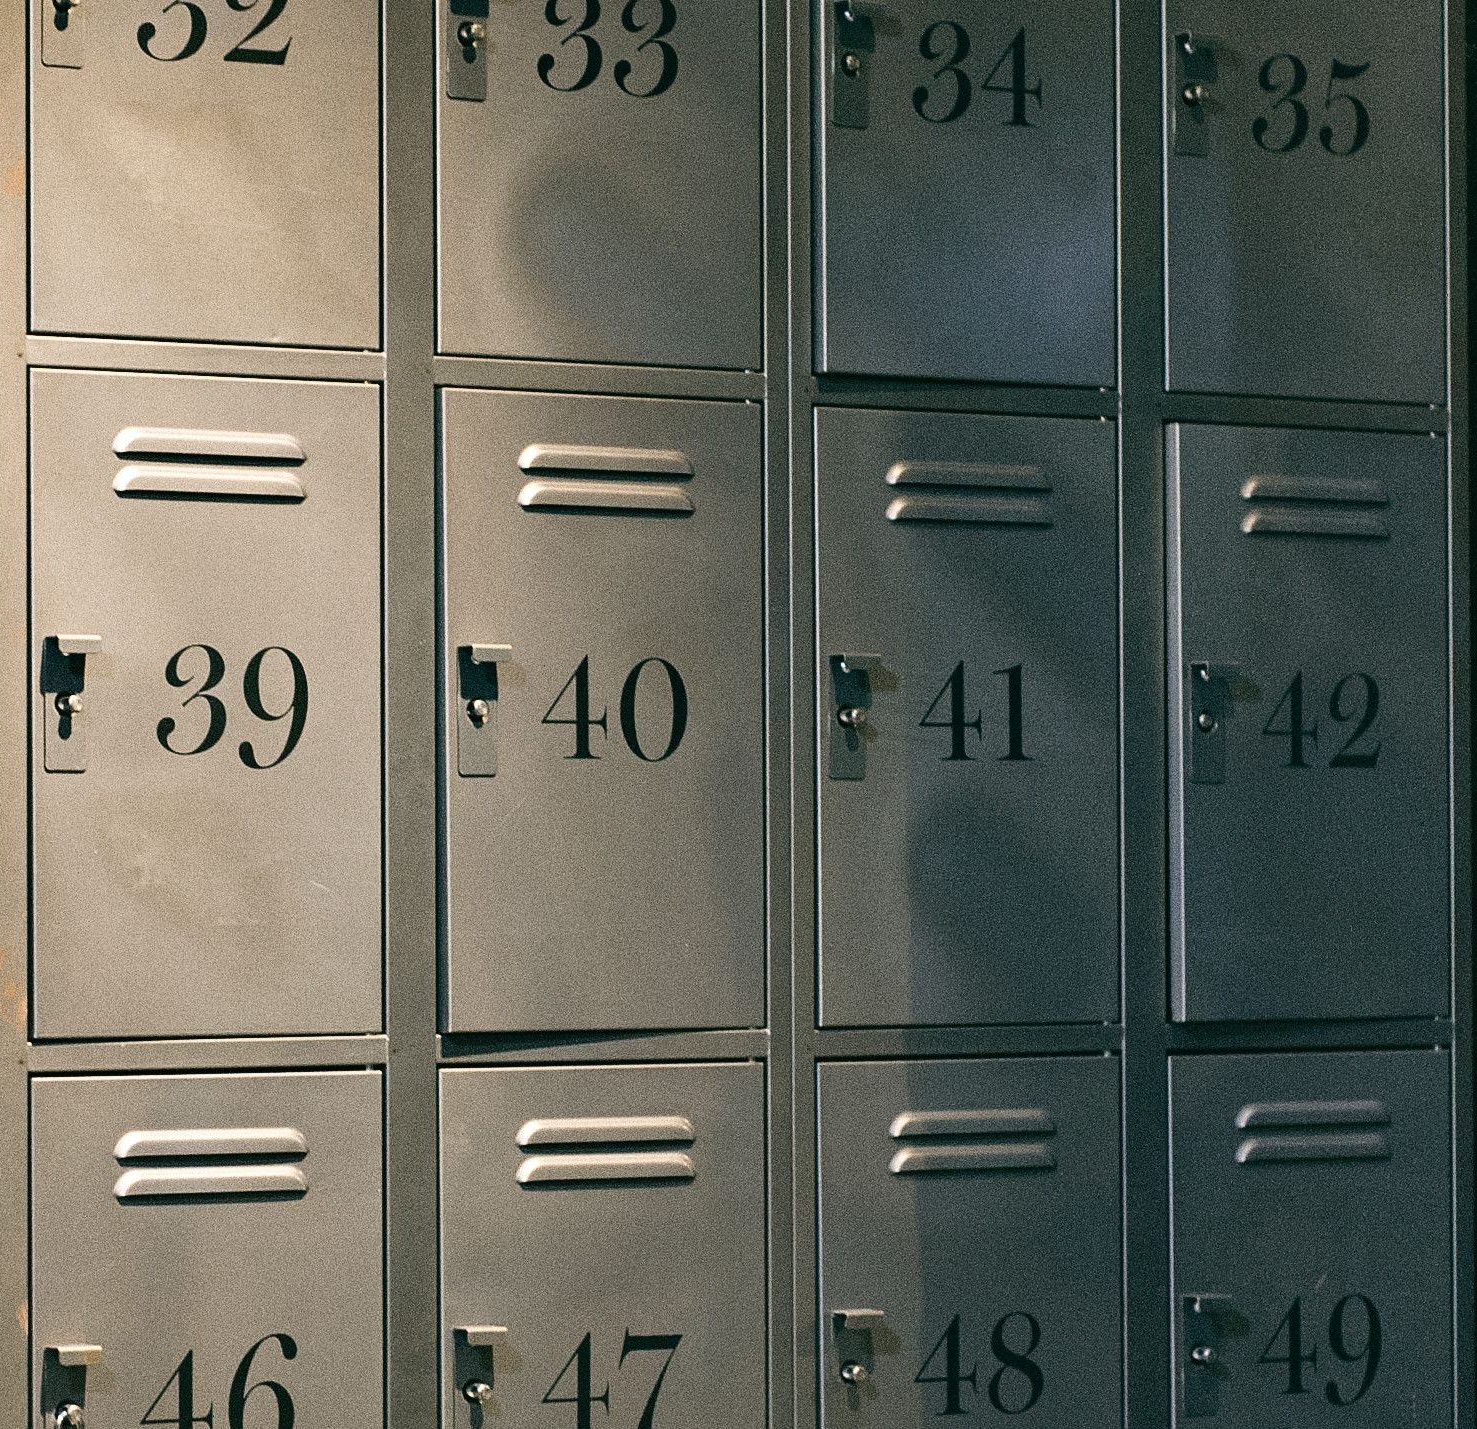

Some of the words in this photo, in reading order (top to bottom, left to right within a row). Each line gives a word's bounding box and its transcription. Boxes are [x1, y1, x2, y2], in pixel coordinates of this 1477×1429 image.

[537, 0, 680, 98] 33
[911, 22, 1044, 127] 34
[1251, 56, 1372, 155] 35
[155, 643, 310, 771] 39
[541, 656, 690, 762] 40
[919, 660, 1032, 763] 41
[1260, 673, 1381, 770] 42
[139, 1332, 300, 1429] 46
[541, 1331, 683, 1429] 47
[914, 1312, 1046, 1416] 48
[1258, 1295, 1383, 1407] 49
